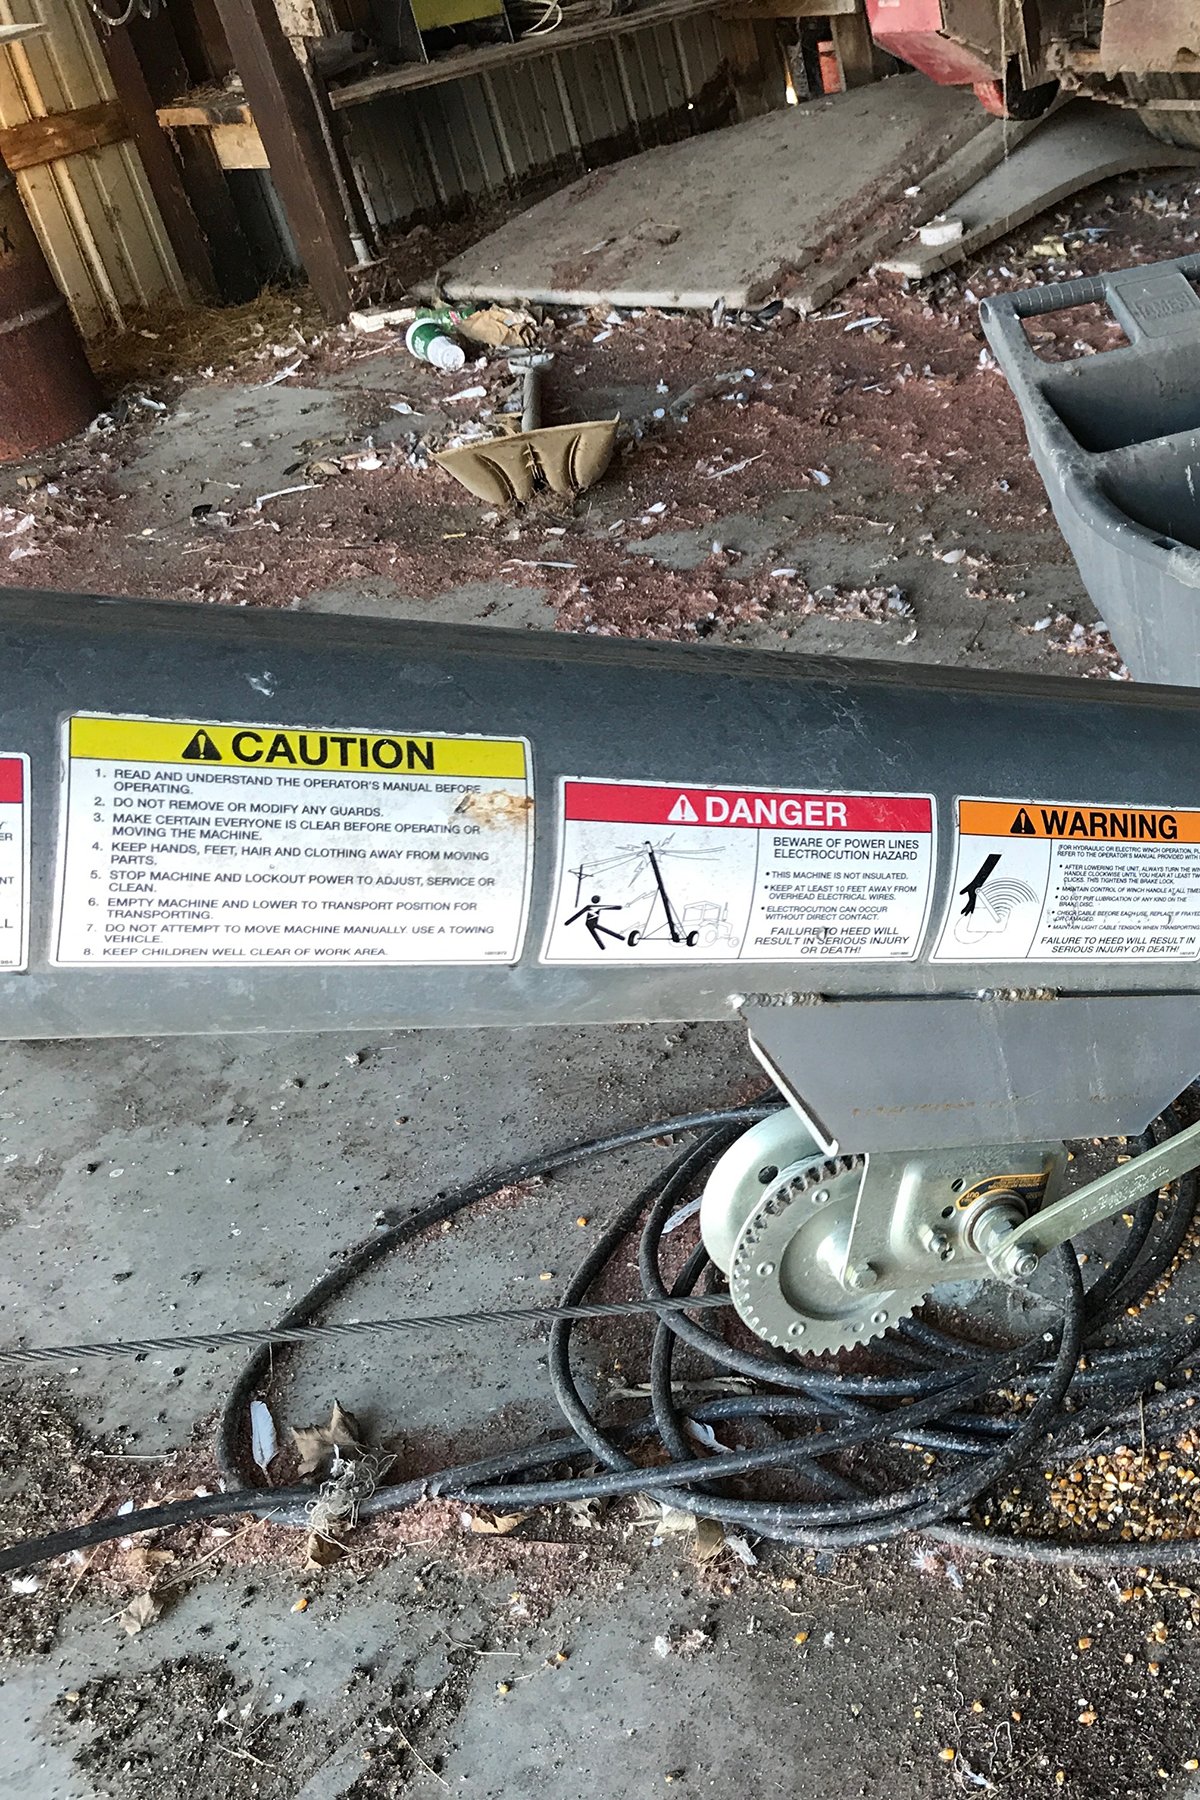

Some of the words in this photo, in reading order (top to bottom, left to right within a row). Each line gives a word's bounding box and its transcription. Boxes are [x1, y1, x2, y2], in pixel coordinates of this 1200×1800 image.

[231, 731, 434, 770] CAUTION
[95, 768, 106, 778] 1.
[114, 769, 150, 780] READ
[154, 770, 182, 781] AND
[185, 772, 272, 785] UNDERSTAND
[277, 776, 300, 786] THE
[303, 777, 379, 789] OPERATOR'S
[382, 780, 432, 792] MANUAL
[434, 782, 480, 794] BEFORE
[113, 781, 194, 794] OPERATING.
[93, 796, 105, 807] 2.
[112, 797, 133, 808] DO
[136, 798, 165, 809] NOT
[168, 799, 224, 811] REMOVE
[227, 802, 246, 812] OR
[249, 802, 298, 814] MODIFY
[301, 805, 326, 815] ANY
[329, 806, 384, 817] GUARDS.
[705, 795, 848, 827] DANGER
[92, 813, 104, 823] 3.
[112, 814, 151, 824] MAKE
[154, 815, 210, 826] CERTAIN
[213, 817, 282, 828] EVERYONE
[284, 819, 296, 829] IS
[299, 819, 340, 830] CLEAR
[343, 821, 391, 832] BEFORE
[394, 822, 461, 834] OPERATING
[462, 824, 482, 835] OR
[1040, 809, 1178, 840] WARNING
[111, 826, 166, 838] MOVING
[171, 828, 196, 838] THE
[199, 829, 262, 840] MACHINE.
[773, 837, 822, 848] BEWARE
[825, 838, 840, 848] OF
[844, 838, 885, 849] POWER
[888, 839, 918, 849] LINES
[91, 841, 102, 851] 4.
[110, 842, 146, 853] KEEP
[150, 843, 199, 855] HANDS,
[203, 844, 237, 856] FEET,
[240, 845, 271, 856] HAIR
[274, 846, 301, 856] AND
[304, 847, 366, 858] CLOTHING
[369, 848, 402, 859] AWAY
[405, 849, 440, 860] FROM
[442, 850, 489, 861] MOVING
[773, 849, 870, 860] ELECTROCUTION
[872, 850, 917, 861] HAZARD
[110, 854, 157, 866] PARTS.
[89, 870, 101, 880] 5.
[109, 871, 146, 881] STOP
[149, 871, 211, 882] MACHINE
[214, 872, 242, 882] AND
[244, 873, 305, 883] LOCKOUT
[308, 874, 354, 884] POWER
[357, 875, 373, 885] TO
[376, 875, 423, 887] ADJUST,
[426, 876, 475, 886] SERVICE
[477, 877, 495, 887] OR
[792, 871, 831, 879] MACHINE
[862, 872, 908, 880] INSULATED.
[108, 883, 156, 893] CLEAN.
[87, 898, 98, 907] 6.
[107, 898, 153, 907] EMPTY
[157, 899, 218, 908] MACHINE
[222, 899, 249, 908] AND
[252, 900, 298, 909] LOWER
[301, 900, 317, 909] TO
[321, 900, 393, 910] TRANSPORT
[396, 901, 450, 910] POSITION
[453, 902, 477, 911] FOR
[108, 910, 213, 920] TRANSPORTING.
[86, 924, 96, 932] 7.
[105, 924, 125, 932] DO
[128, 924, 155, 933] NOT
[161, 924, 220, 933] ATTEMPT
[225, 924, 241, 933] TO
[244, 924, 280, 933] MOVE
[283, 925, 340, 934] MACHINE
[343, 925, 408, 934] MANUALLY.
[411, 925, 435, 934] USE
[437, 925, 446, 934] A
[450, 925, 494, 934] TOWING
[770, 927, 820, 935] FAILURE
[823, 927, 838, 935] TO
[840, 927, 871, 935] HEED
[873, 927, 899, 935] WILL
[104, 935, 163, 943] VEHICLE.
[754, 937, 799, 945] RESULT
[802, 937, 815, 945] IN
[817, 937, 866, 945] SERIOUS
[870, 937, 910, 945] INJURY
[1040, 936, 1082, 945] FAILURE
[1084, 936, 1097, 945] TO
[1098, 936, 1125, 945] HEED
[1126, 936, 1148, 944] WILL
[1149, 936, 1184, 944] RESULT
[1186, 936, 1196, 944] IN
[83, 948, 94, 956] 8.
[102, 948, 137, 956] KEEP
[141, 948, 208, 956] CHILDREN
[212, 948, 245, 956] WELL
[249, 948, 291, 956] CLEAR
[294, 948, 310, 956] OF
[314, 948, 350, 956] WORK
[354, 948, 388, 956] AREA.
[800, 946, 818, 954] OR
[820, 946, 861, 954] DEATH!
[1095, 945, 1130, 953] INJURY
[1131, 945, 1146, 953] OR
[1146, 945, 1180, 953] DEATH!
